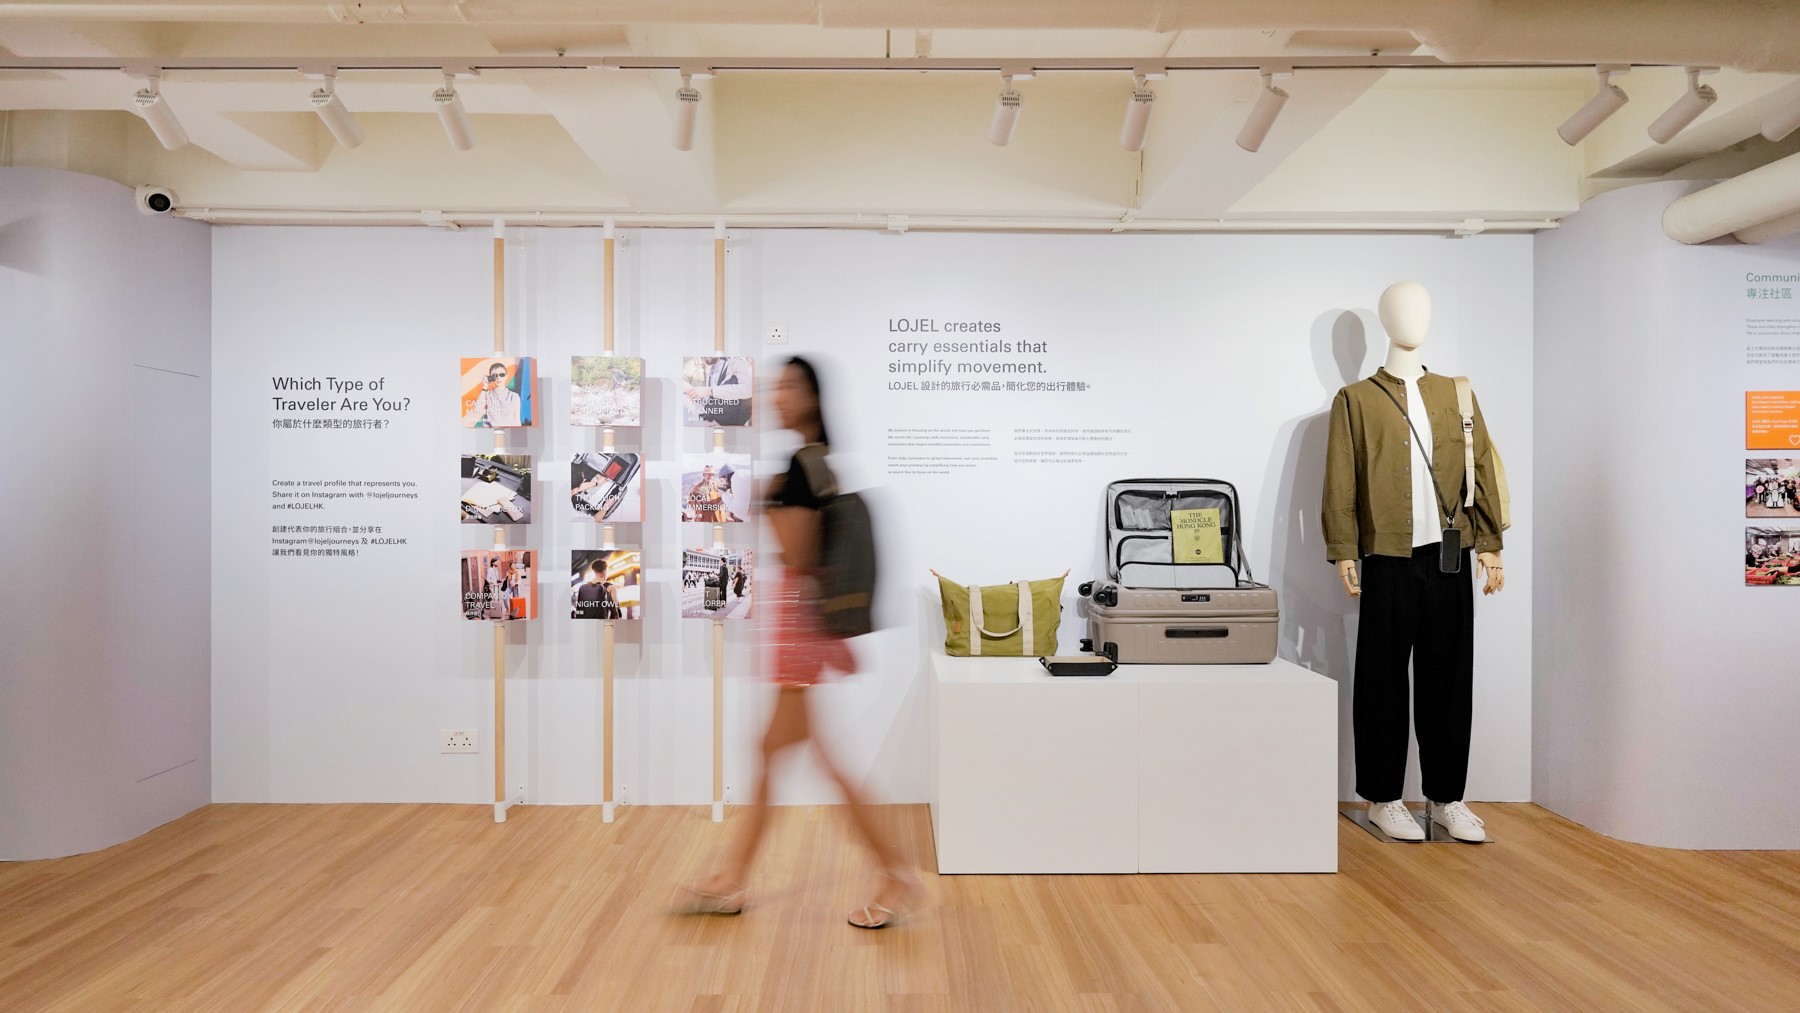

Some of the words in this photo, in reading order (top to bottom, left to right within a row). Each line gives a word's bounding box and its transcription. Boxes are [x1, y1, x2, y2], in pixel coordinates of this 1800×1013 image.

[1746, 288, 1792, 299] 專注社區
[889, 318, 939, 332] LOJEL
[944, 320, 1001, 333] creates
[888, 342, 928, 355] carry
[933, 340, 1011, 353] essentials
[1016, 340, 1048, 353] that
[888, 359, 952, 376] simplify
[957, 361, 1047, 373] movement.
[272, 377, 321, 390] Which
[326, 377, 363, 393] Type
[368, 377, 385, 390] of
[888, 382, 918, 391] LOJEL
[272, 397, 336, 411] Traveler
[340, 398, 368, 411] Are
[372, 397, 411, 411] You?
[272, 480, 295, 488] Create
[302, 480, 323, 488] travel
[324, 480, 347, 489] profile
[348, 480, 362, 488] that
[363, 480, 401, 489] represents
[402, 481, 418, 490] you.
[311, 491, 347, 500] Instagram
[366, 491, 419, 500] @lojeljourneys
[272, 502, 286, 510] and
[287, 502, 326, 510] #LOJELHK.
[575, 503, 609, 511] PACKING
[361, 537, 369, 545] 及
[370, 537, 408, 545] #LOJELHK
[465, 592, 514, 600] COMPANON
[465, 601, 495, 609] TRAVEL
[575, 600, 600, 608] NIGHT
[601, 600, 620, 608] OWL
